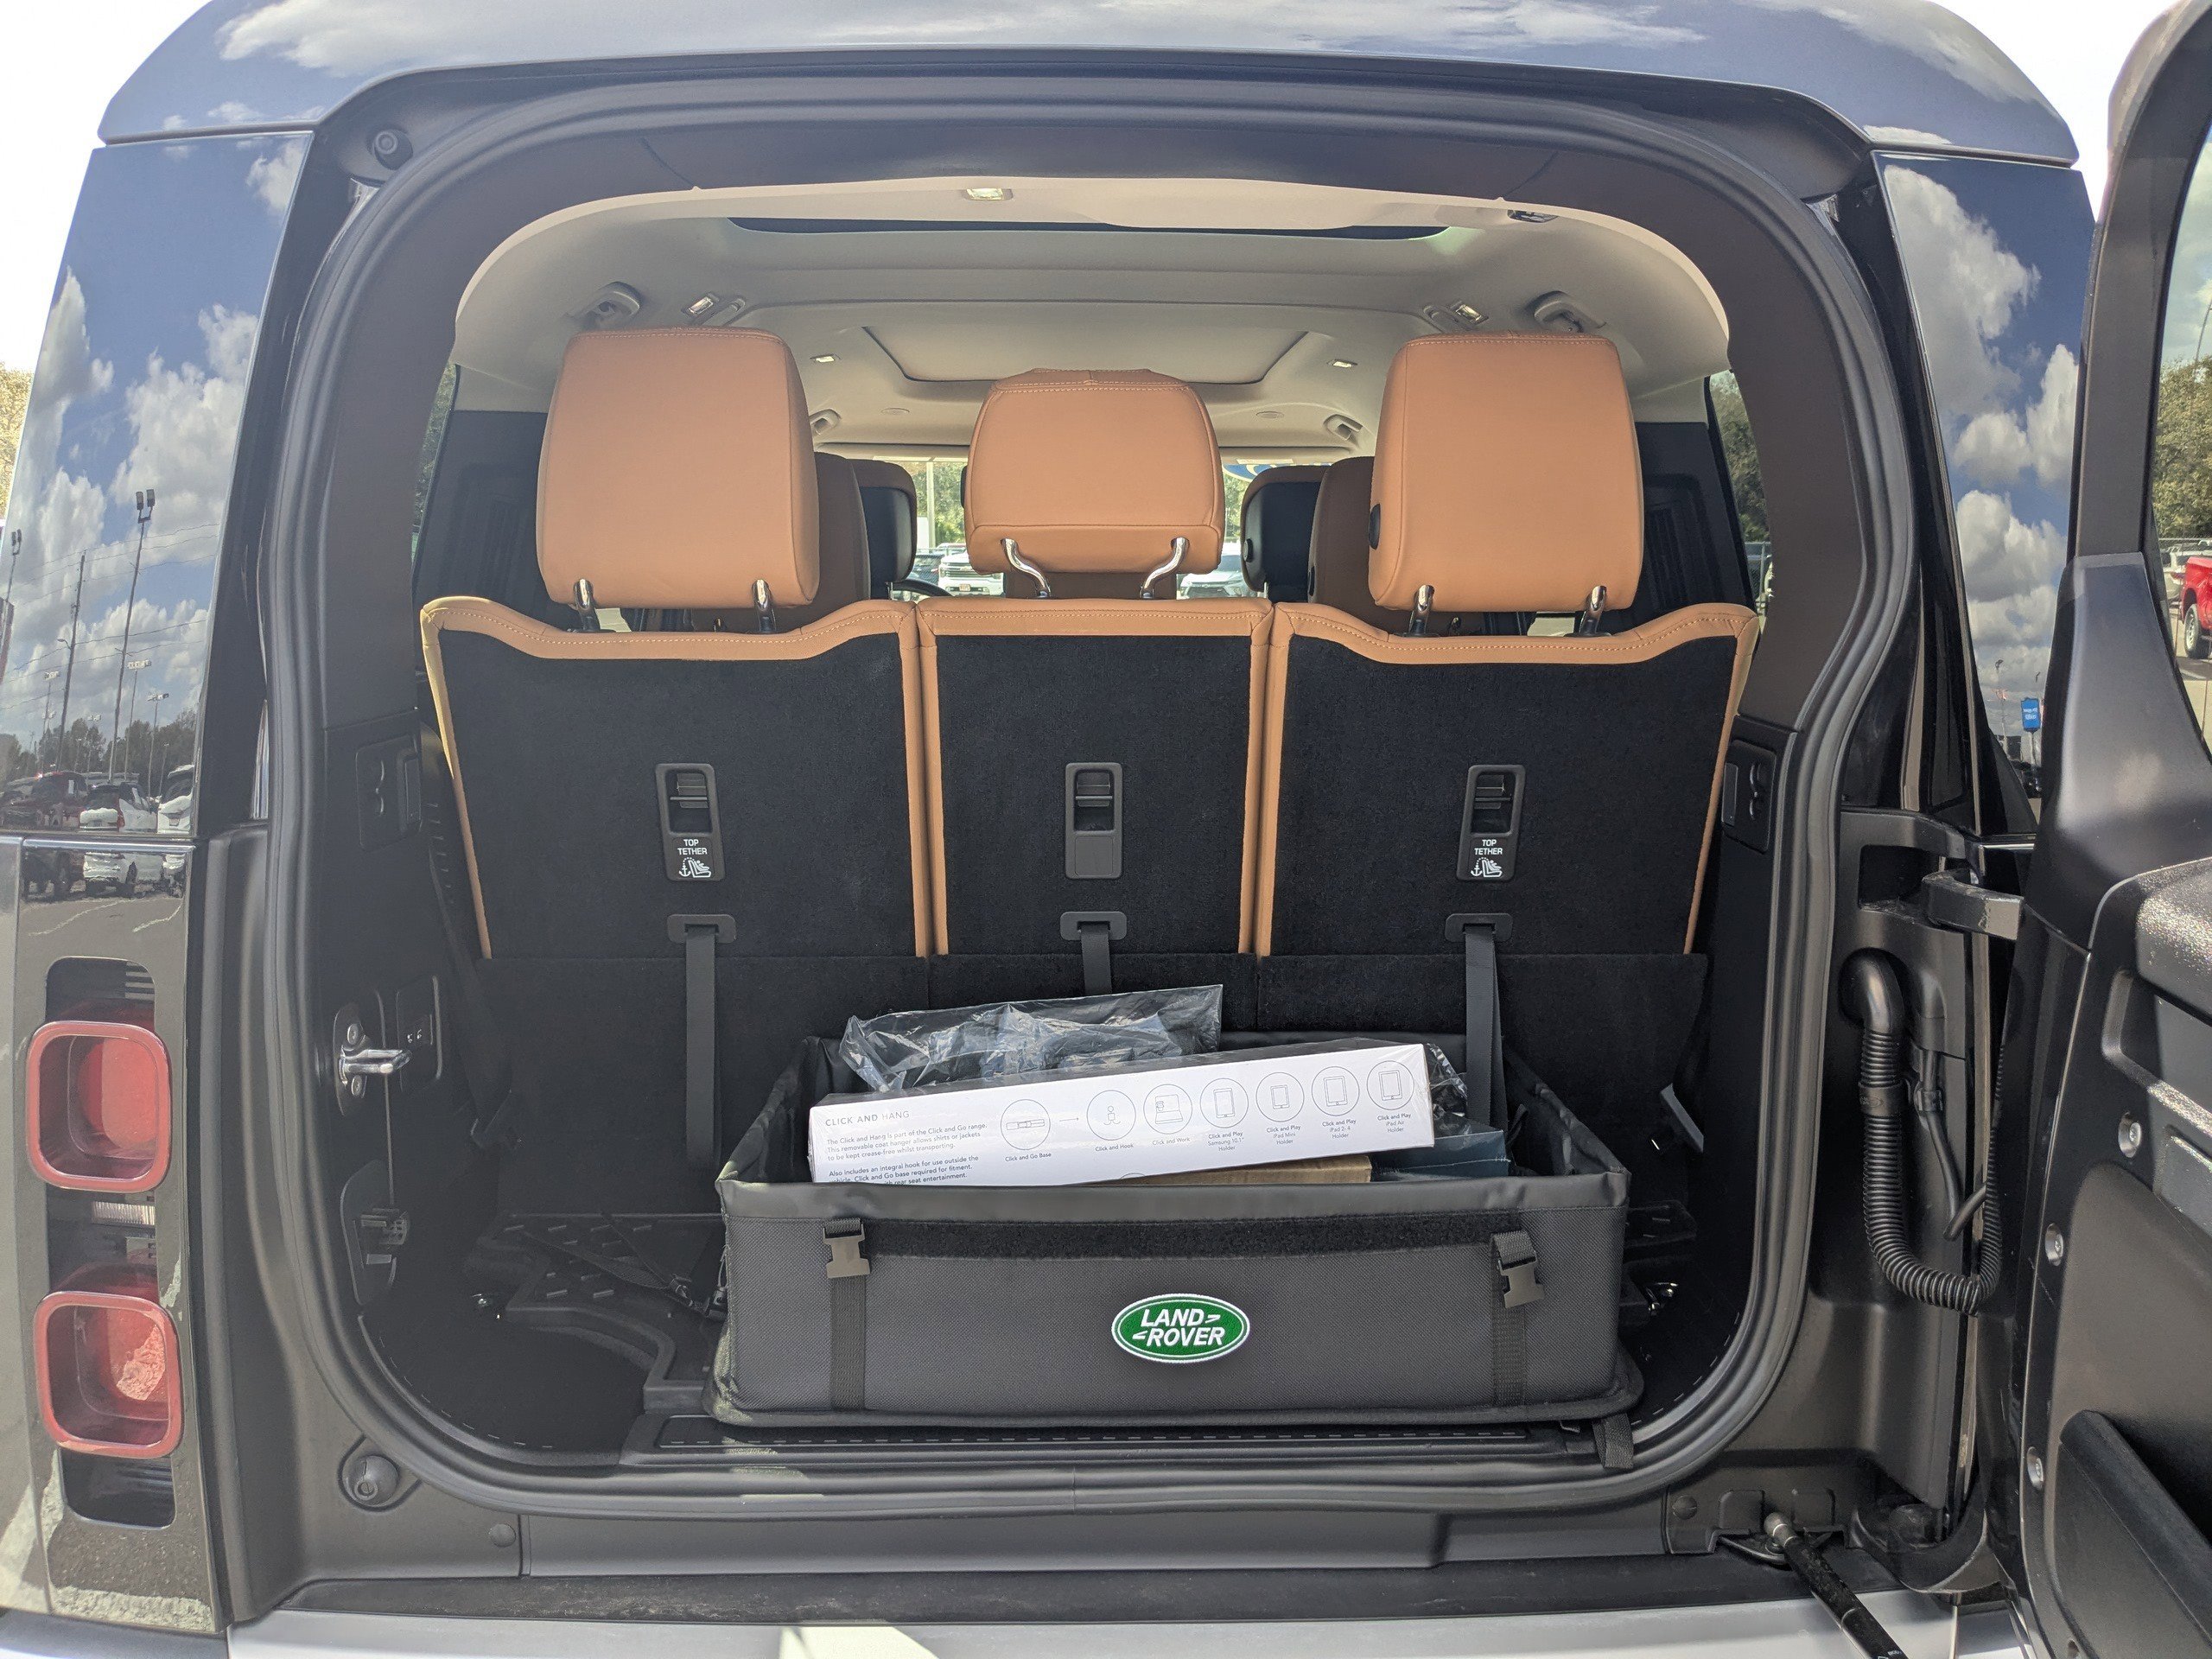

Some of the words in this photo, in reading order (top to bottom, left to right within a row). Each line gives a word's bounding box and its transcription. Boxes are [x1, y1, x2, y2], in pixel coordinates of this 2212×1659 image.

[683, 838, 699, 847] TOP
[677, 847, 708, 855] TETHER
[1474, 847, 1503, 855] TETHER
[825, 1116, 853, 1127] CLICK
[856, 1114, 879, 1123] AND
[881, 1110, 911, 1121] HANG
[841, 1143, 874, 1152] removable
[861, 1148, 896, 1158] crease-free
[916, 1142, 956, 1152] transporting.
[880, 1163, 904, 1172] integral
[911, 1166, 938, 1175] required
[923, 1173, 968, 1182] entertainment.
[1141, 1309, 1205, 1327] LAND
[1147, 1327, 1225, 1347] ROVER
